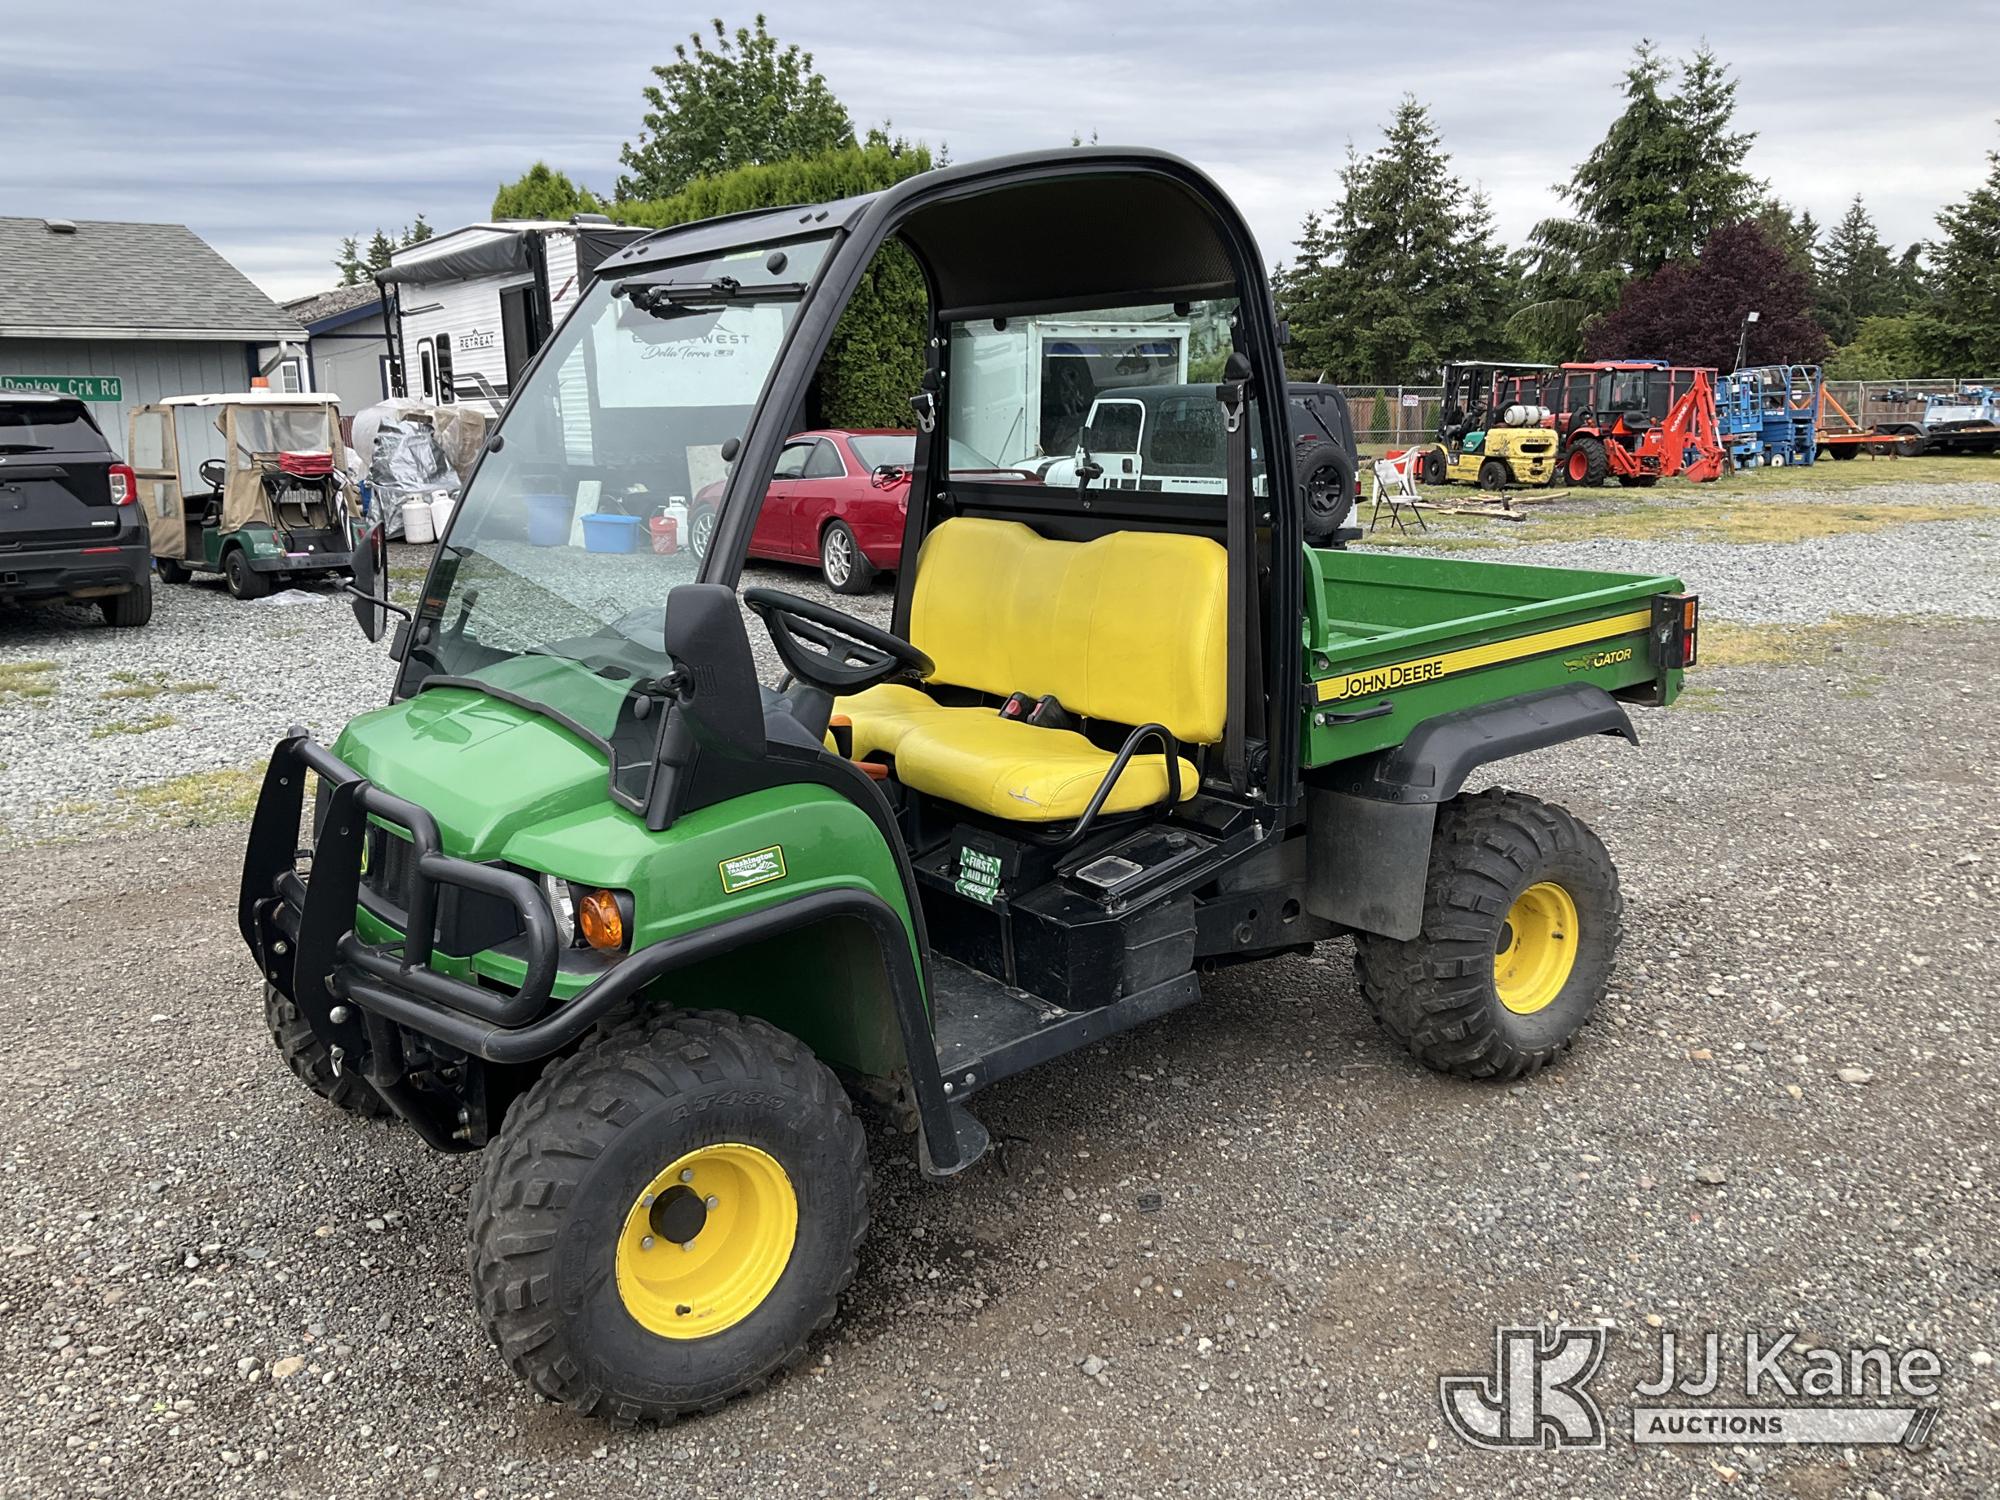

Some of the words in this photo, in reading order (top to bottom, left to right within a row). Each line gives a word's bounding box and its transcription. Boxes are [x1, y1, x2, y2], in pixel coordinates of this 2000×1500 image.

[460, 335, 494, 348] RETREAT
[701, 334, 750, 344] WEST
[68, 379, 93, 395] Crk
[101, 379, 118, 395] Rd
[1594, 648, 1633, 668] GATOR
[1340, 673, 1386, 697] JOHN
[1390, 661, 1443, 686] DEERE
[726, 852, 774, 871] Washington
[727, 863, 757, 875] TRACTOR
[969, 856, 993, 873] FIRST
[967, 868, 982, 881] AID
[981, 873, 996, 886] KIT
[667, 1090, 786, 1127] AT489
